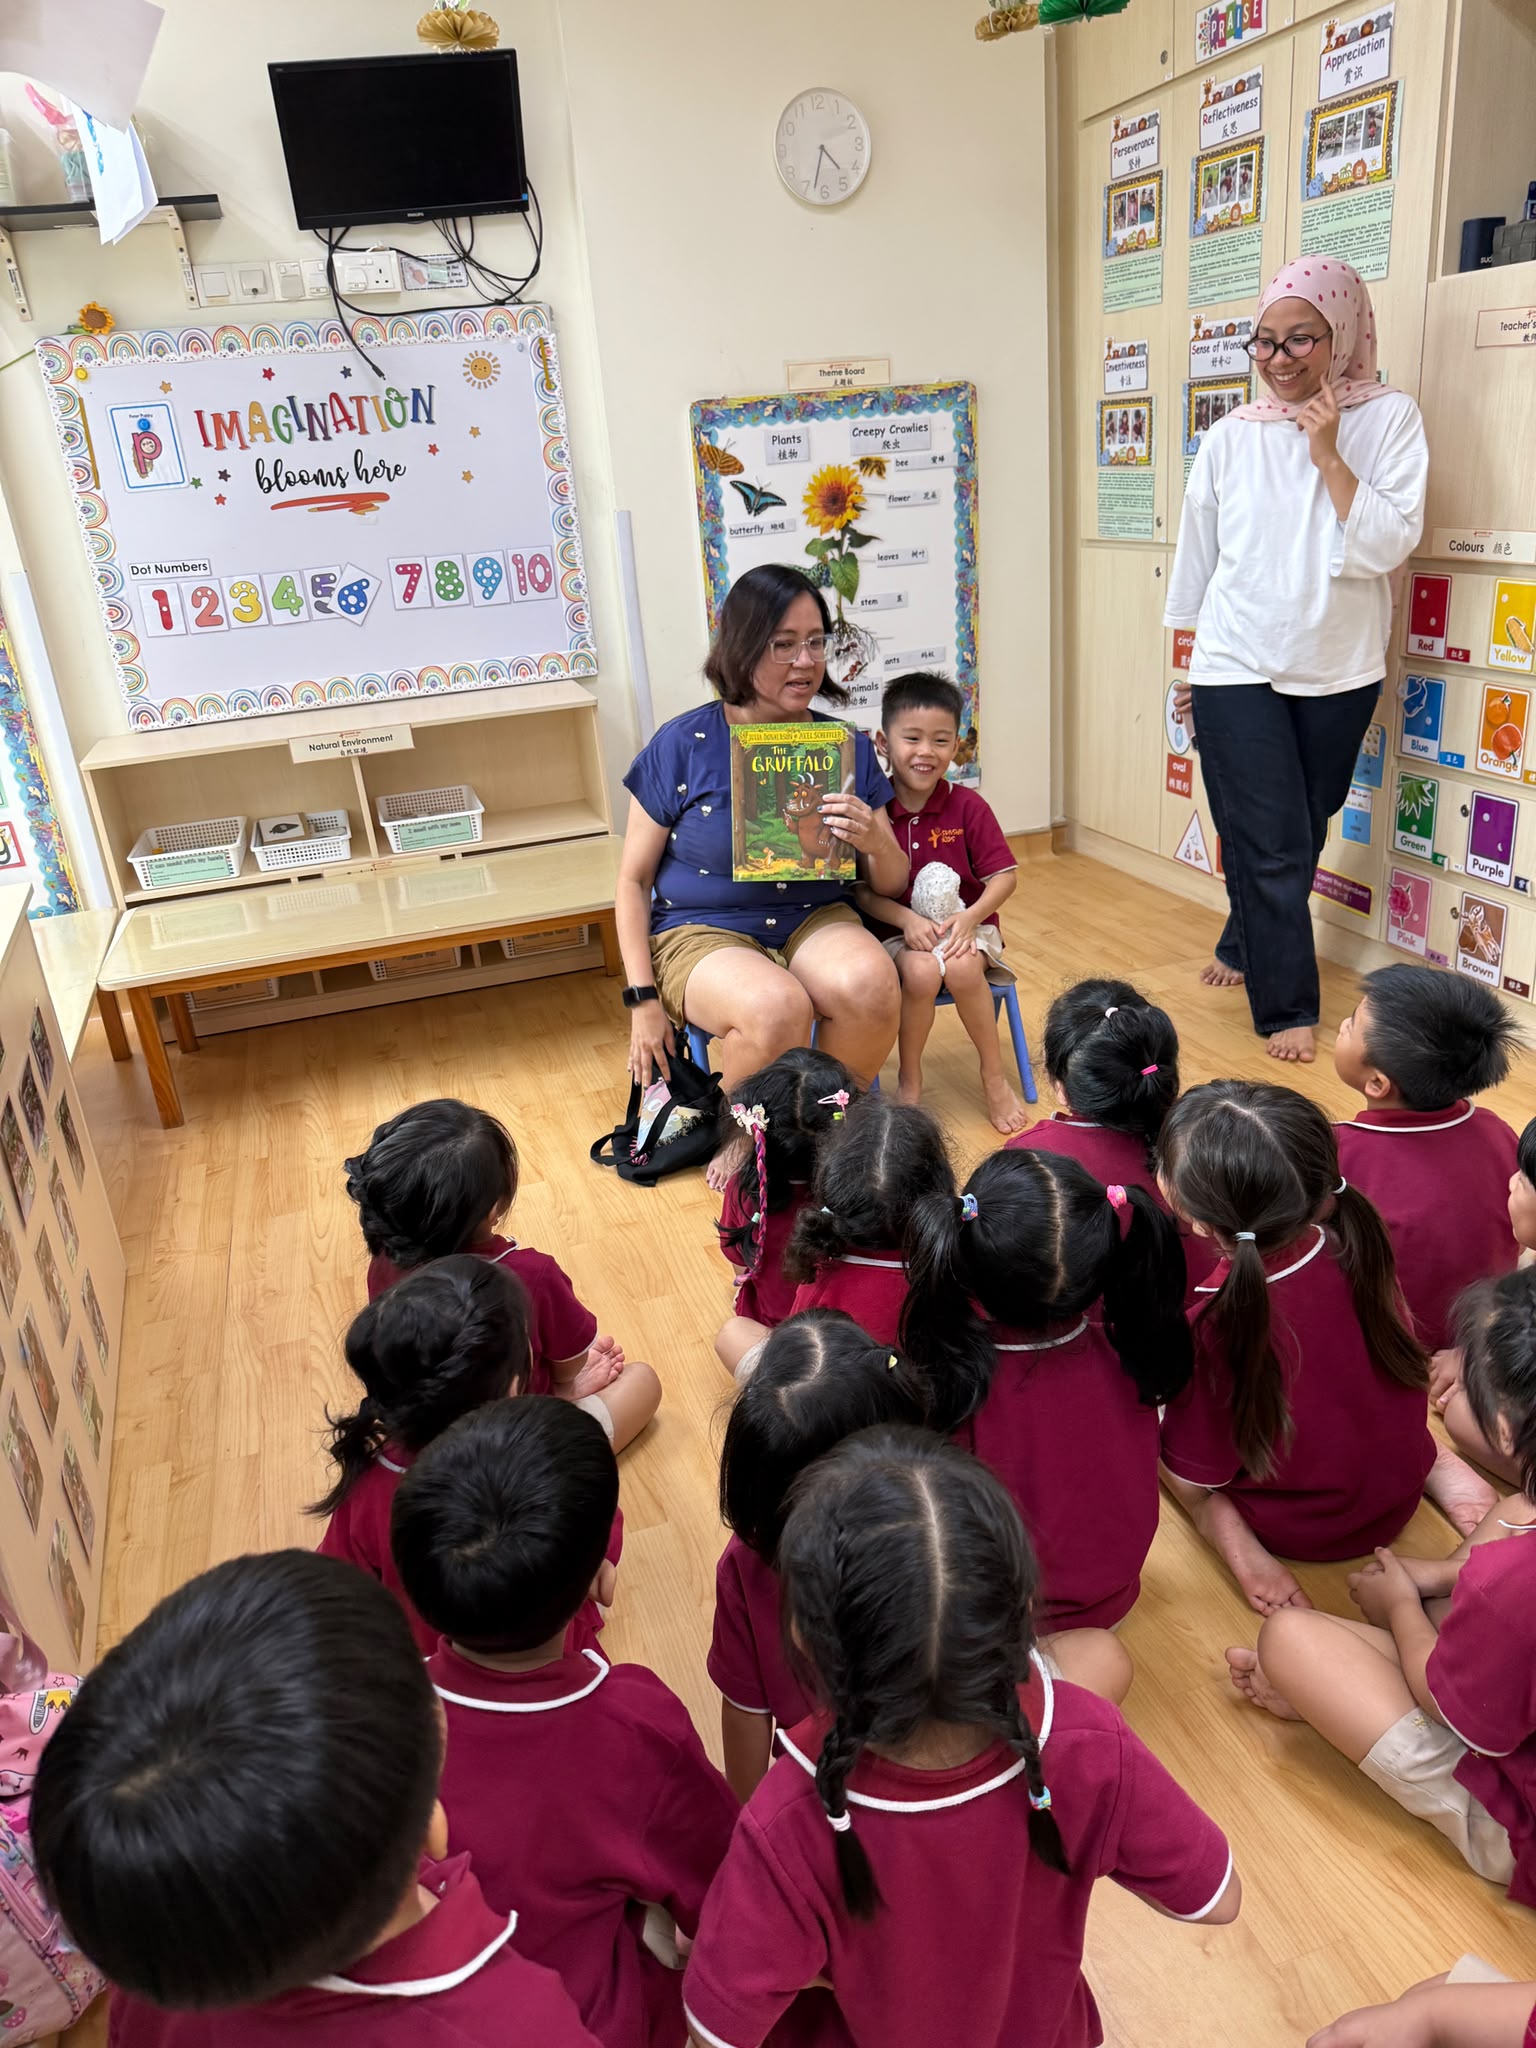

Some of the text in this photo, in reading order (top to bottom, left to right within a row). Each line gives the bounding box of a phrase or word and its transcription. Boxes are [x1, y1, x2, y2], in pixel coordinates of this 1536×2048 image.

[1210, 0, 1260, 41] PRAISE
[1324, 36, 1385, 72] Appreciation
[794, 102, 805, 119] 11
[810, 94, 825, 111] 12
[834, 98, 840, 115] 1
[1202, 96, 1259, 126] Reflectiveness
[782, 121, 795, 137] 10
[846, 114, 857, 130] 2
[854, 136, 864, 152] 3
[1113, 136, 1155, 160] Perseverance
[786, 165, 796, 180] 8
[851, 159, 861, 175] 4
[801, 180, 811, 196] 7
[820, 184, 830, 200] 6
[838, 176, 848, 192] 5
[1191, 344, 1210, 355] Sense
[1212, 341, 1220, 353] of
[819, 367, 865, 377] Theme Board
[1105, 360, 1146, 373] Inventiveness
[194, 385, 436, 451] IMAGINATION
[852, 422, 929, 438] Creepy Crawlies
[771, 434, 802, 446] Plants
[777, 448, 799, 461] 植物
[895, 458, 909, 467] bee
[255, 449, 407, 494] blooms here
[888, 494, 911, 503] flower
[729, 523, 764, 537] butterfly
[1449, 539, 1485, 553] Colours
[877, 552, 899, 562] leaves
[131, 561, 208, 577] Dot Numbers
[395, 553, 553, 604] 7 8 9 10
[151, 572, 371, 631] 1 2 3 4 5 6
[860, 598, 879, 607] stem
[1417, 639, 1434, 651] Red
[884, 656, 900, 665] ants
[1494, 647, 1527, 664] Yellow
[309, 741, 340, 752] Natural
[341, 734, 393, 748] Environment
[771, 745, 787, 755] THE
[1410, 739, 1429, 753] Blue
[751, 755, 834, 773] GRUFFALO
[1172, 761, 1187, 774] oval
[1480, 752, 1519, 773] Orange
[1400, 836, 1427, 853] Green
[1473, 858, 1504, 878] Purple
[1396, 930, 1417, 947] Pink
[1461, 957, 1494, 980] Brown
